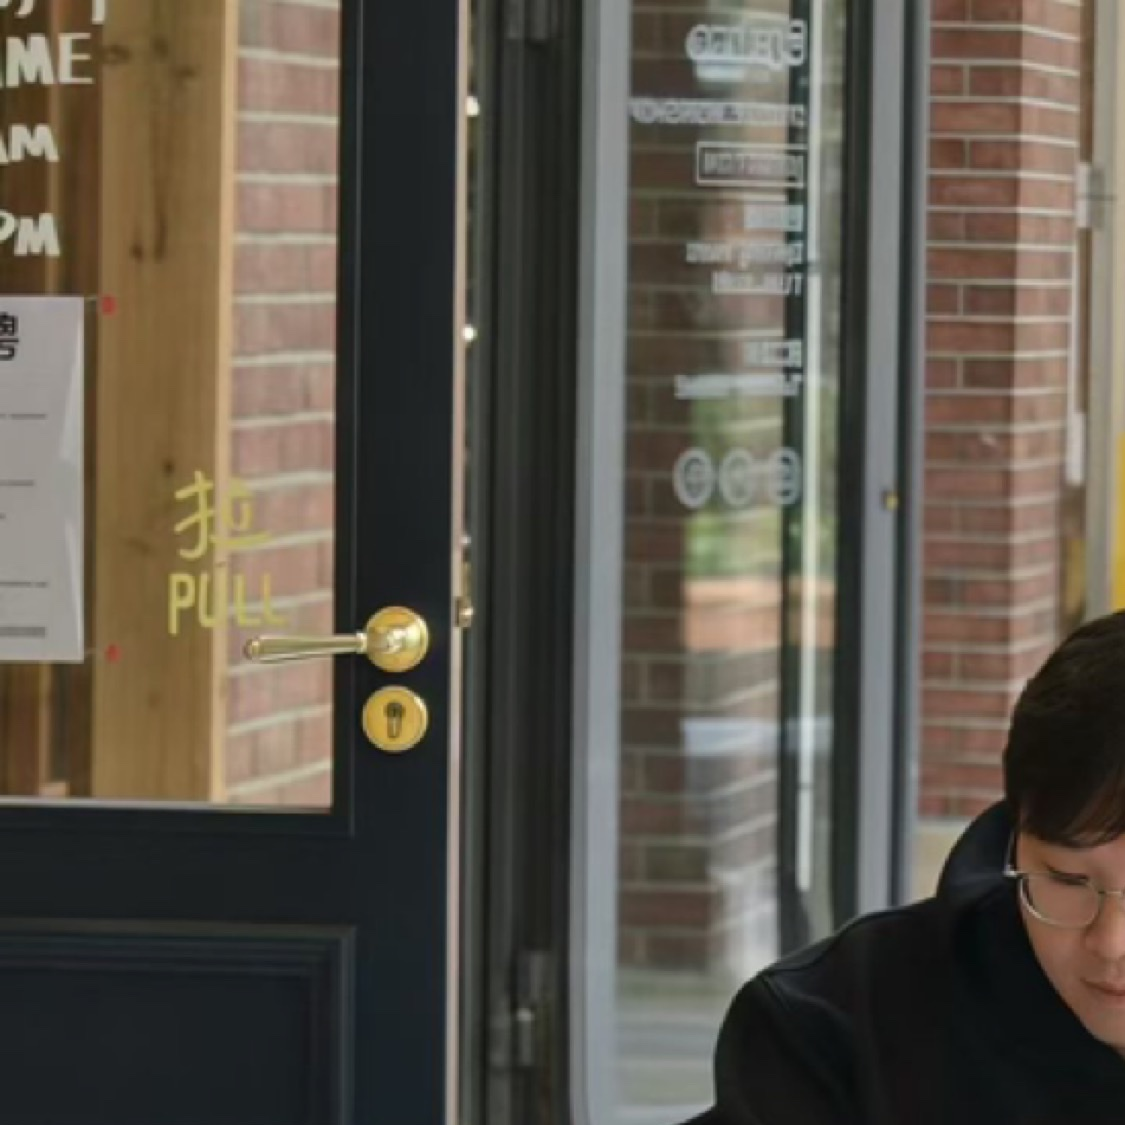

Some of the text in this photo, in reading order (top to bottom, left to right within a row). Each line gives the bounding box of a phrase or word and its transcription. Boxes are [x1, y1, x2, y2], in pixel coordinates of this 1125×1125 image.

[0, 32, 94, 88] ME
[0, 123, 60, 166] M
[174, 470, 272, 562] 拉
[168, 572, 289, 636] PULL
